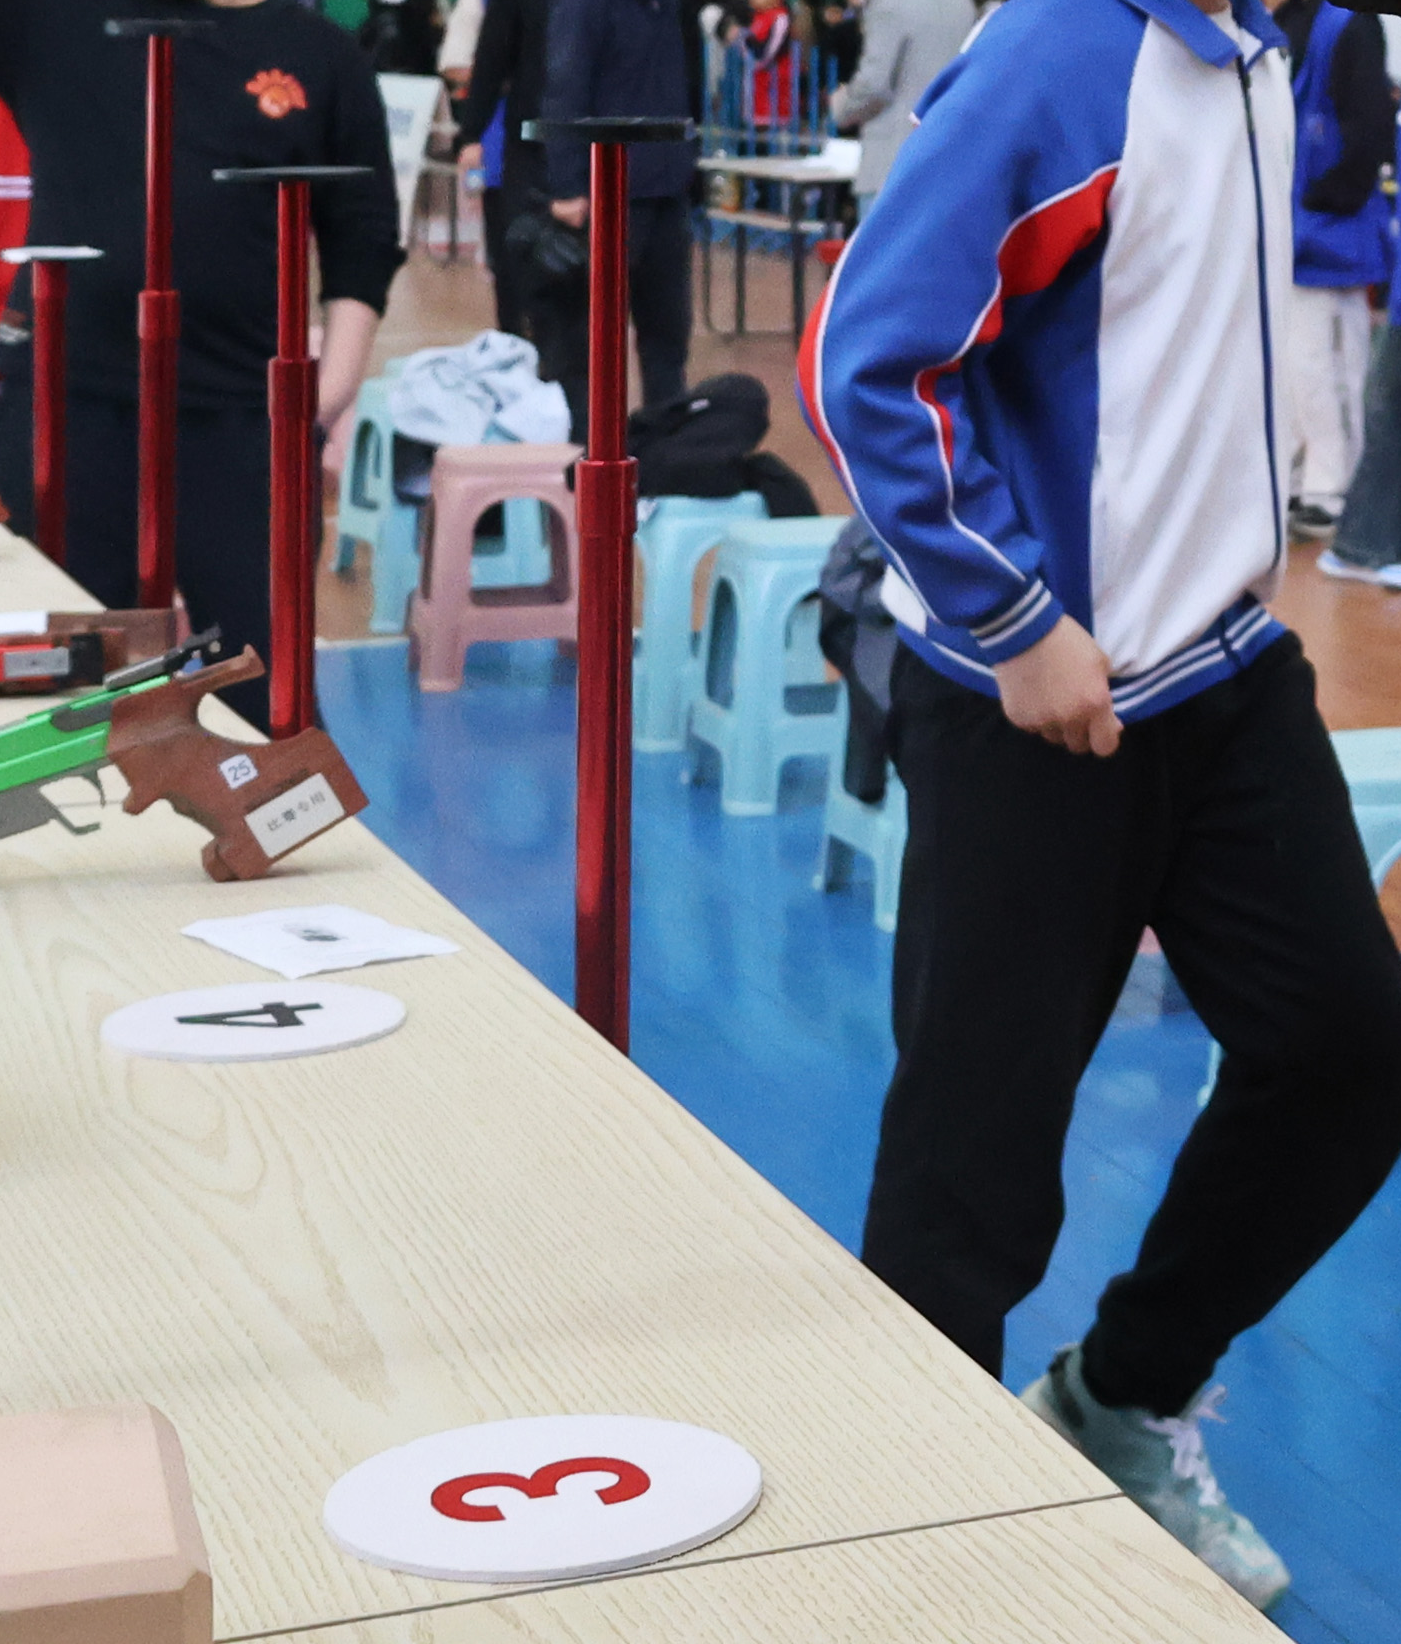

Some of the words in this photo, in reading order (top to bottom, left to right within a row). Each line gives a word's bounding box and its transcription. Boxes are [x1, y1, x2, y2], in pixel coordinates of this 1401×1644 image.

[227, 760, 251, 781] 25
[174, 1001, 324, 1028] 4
[430, 1456, 652, 1523] 3
